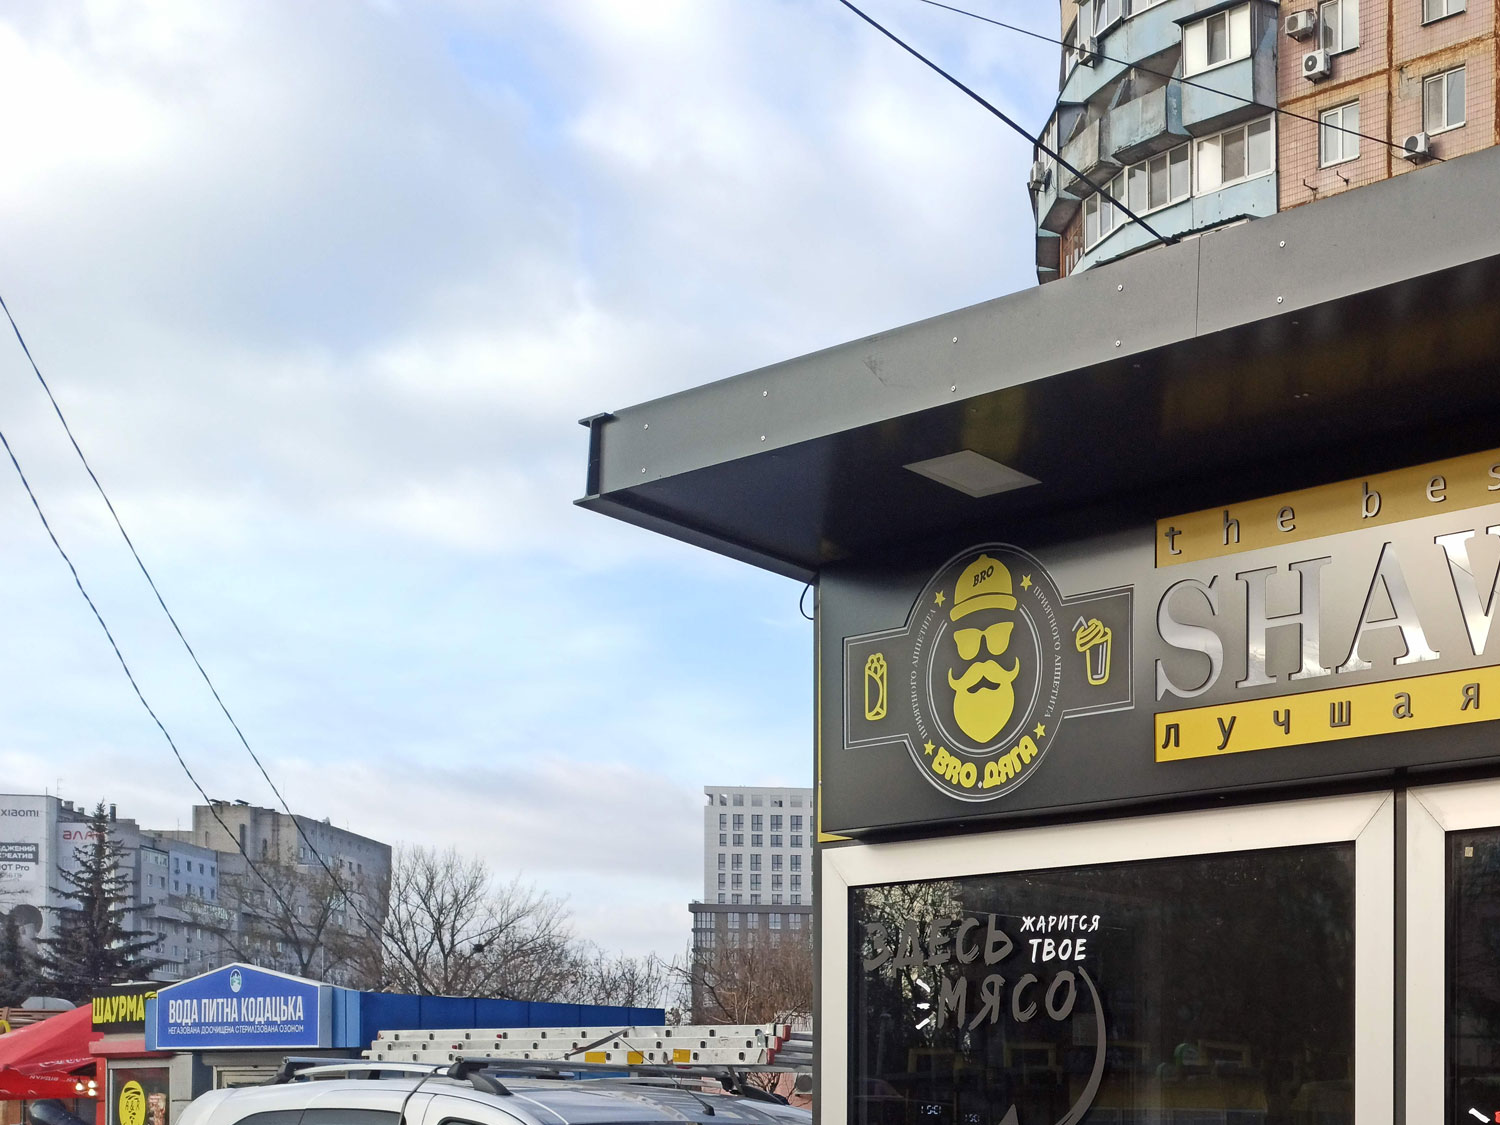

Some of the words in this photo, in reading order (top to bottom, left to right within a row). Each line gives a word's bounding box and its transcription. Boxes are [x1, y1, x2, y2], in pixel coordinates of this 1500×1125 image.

[1164, 505, 1297, 556] the
[972, 565, 995, 588] BRO
[1162, 682, 1480, 751] лучшая
[1020, 914, 1101, 934] ЖАРИТСЯ
[863, 914, 1014, 979] ЗДЕСЬ
[1028, 938, 1088, 963] ТВОЕ
[92, 993, 146, 1025] ШАУРМА
[168, 999, 199, 1026] ВОДА
[201, 997, 239, 1023] ПИТНА
[241, 995, 304, 1025] КОДАЦЬКА
[936, 969, 1078, 1032] МЯСО
